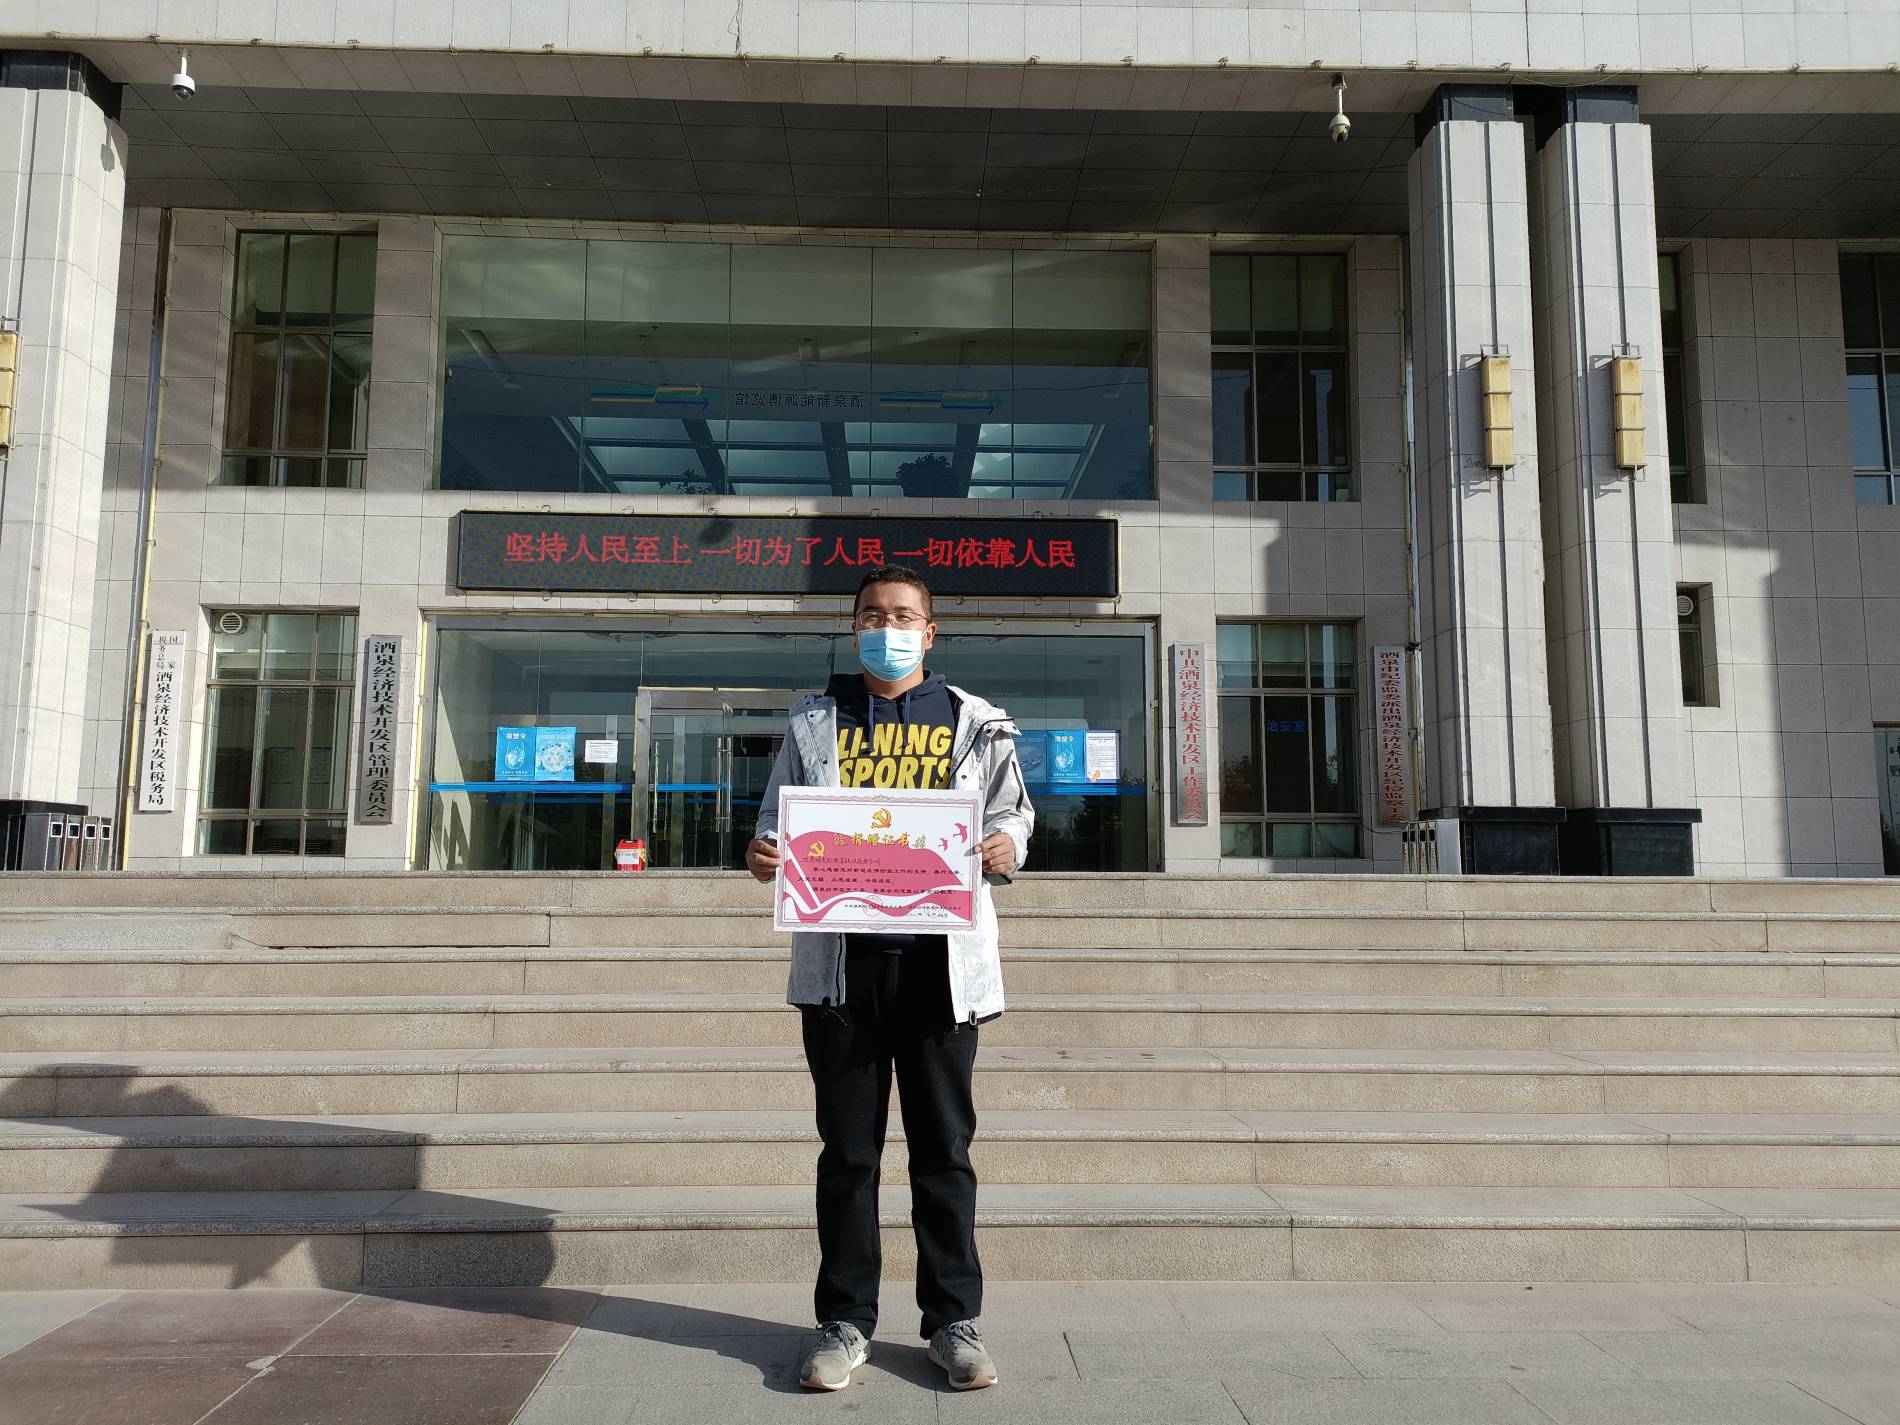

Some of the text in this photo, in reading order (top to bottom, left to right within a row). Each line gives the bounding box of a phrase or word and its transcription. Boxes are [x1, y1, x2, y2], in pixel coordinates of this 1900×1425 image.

[504, 533, 1075, 568] 坚持人民至上 一切为了人民 一切依靠人民
[148, 671, 173, 806] 酒泉经济技术开发区税务局
[366, 641, 397, 818] 酒泉经济技术开发区管理委员会
[838, 723, 952, 759] LI-NING
[1179, 649, 1204, 820] 中共酒泉经济技术开发区工作委员会
[840, 757, 951, 789] SPORTS
[851, 832, 910, 847] 捐赠证书
